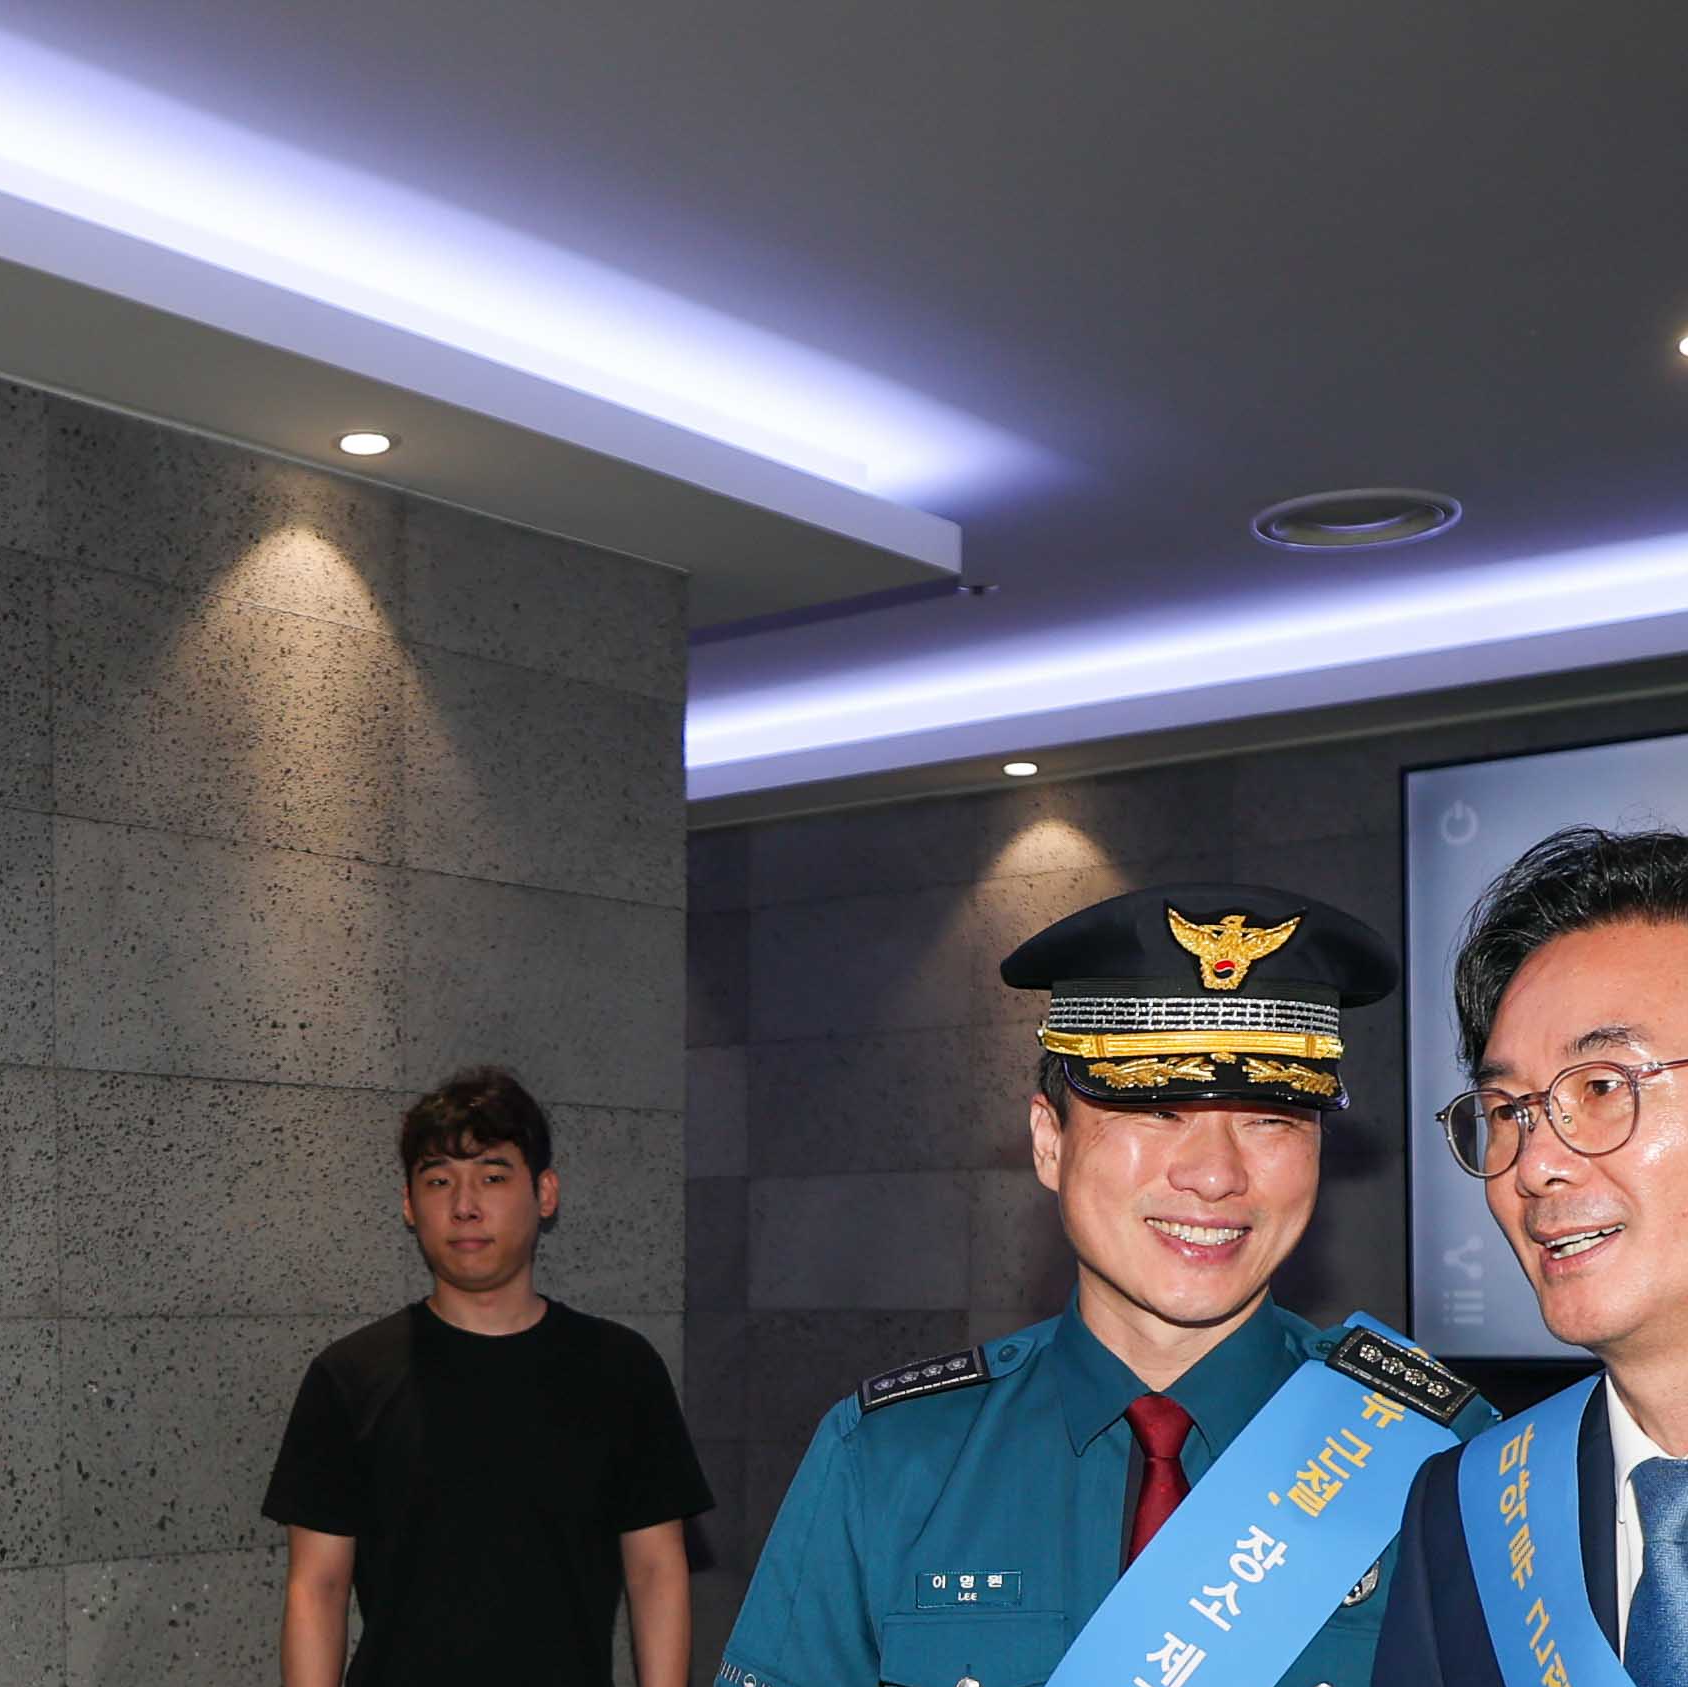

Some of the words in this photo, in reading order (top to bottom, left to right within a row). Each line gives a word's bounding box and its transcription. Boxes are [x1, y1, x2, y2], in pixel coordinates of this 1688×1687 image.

[1497, 1423, 1537, 1591] 마약류
[957, 1591, 978, 1601] LEE
[1189, 1525, 1288, 1632] 장소
